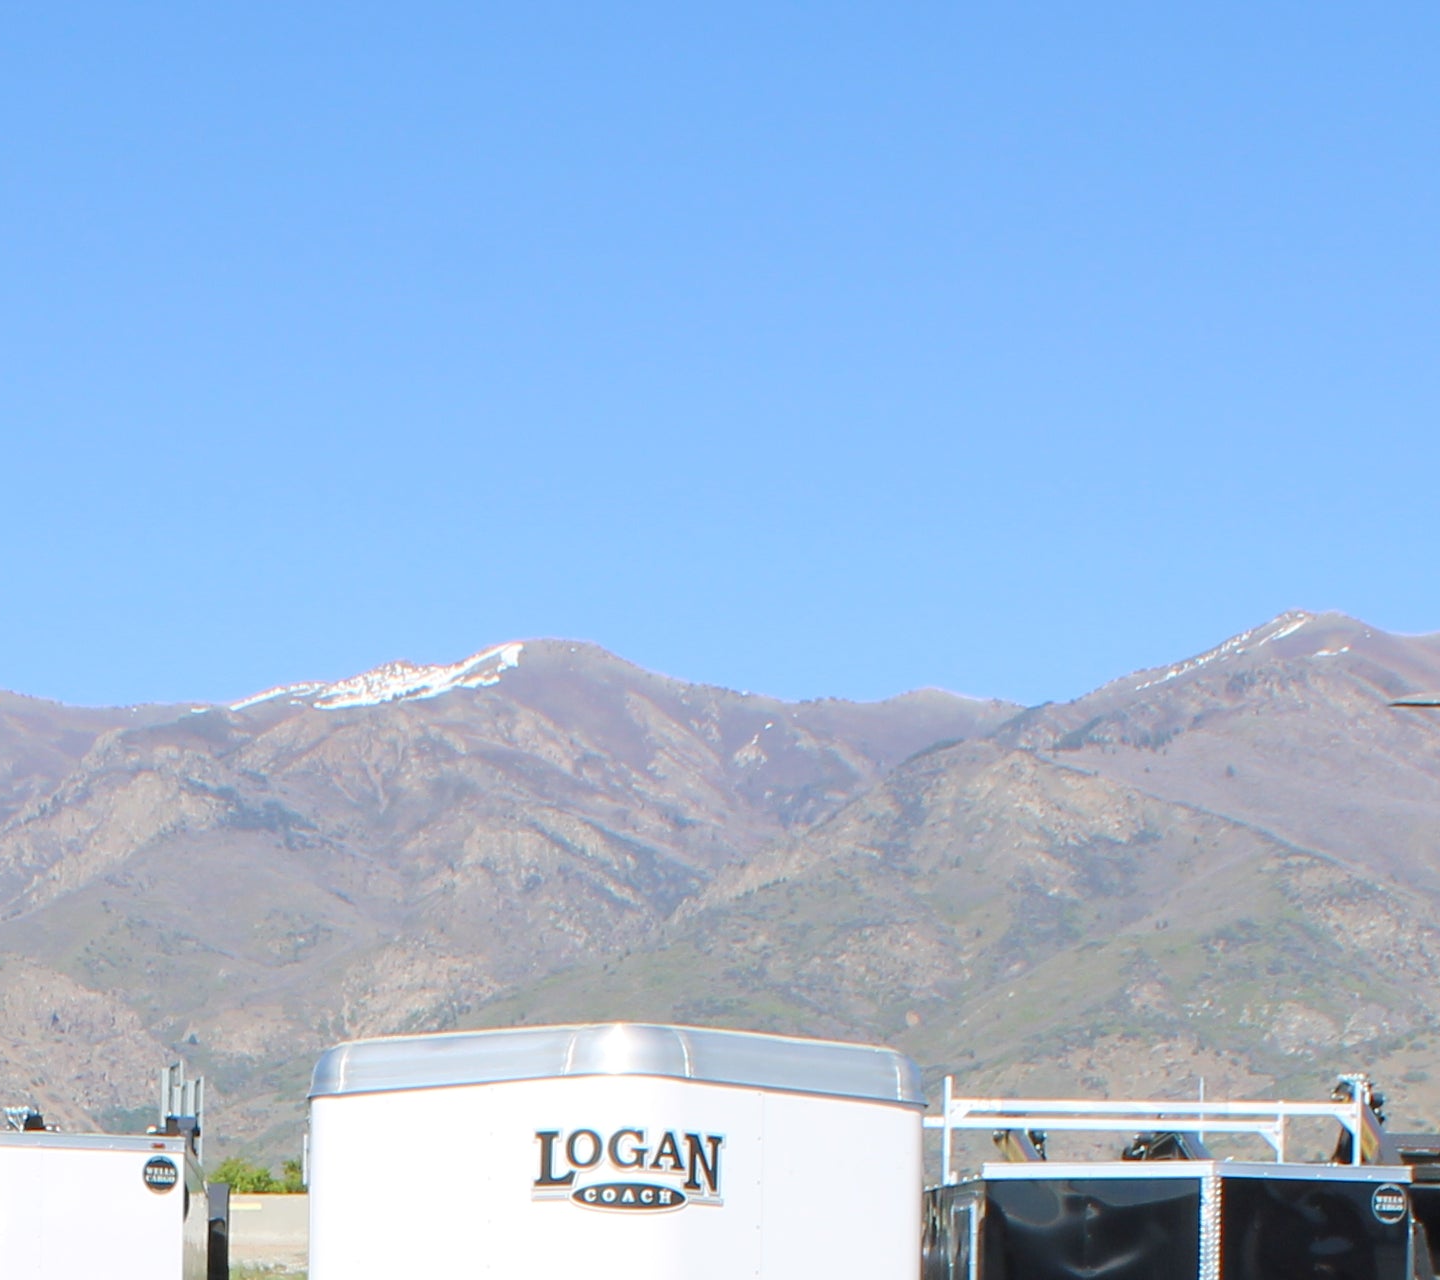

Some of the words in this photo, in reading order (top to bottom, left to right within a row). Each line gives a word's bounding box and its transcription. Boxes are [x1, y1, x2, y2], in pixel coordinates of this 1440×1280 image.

[534, 1128, 724, 1192] LOGAN
[146, 1166, 175, 1175] WELLS
[146, 1175, 175, 1183] CARGO
[583, 1188, 672, 1204] COACH
